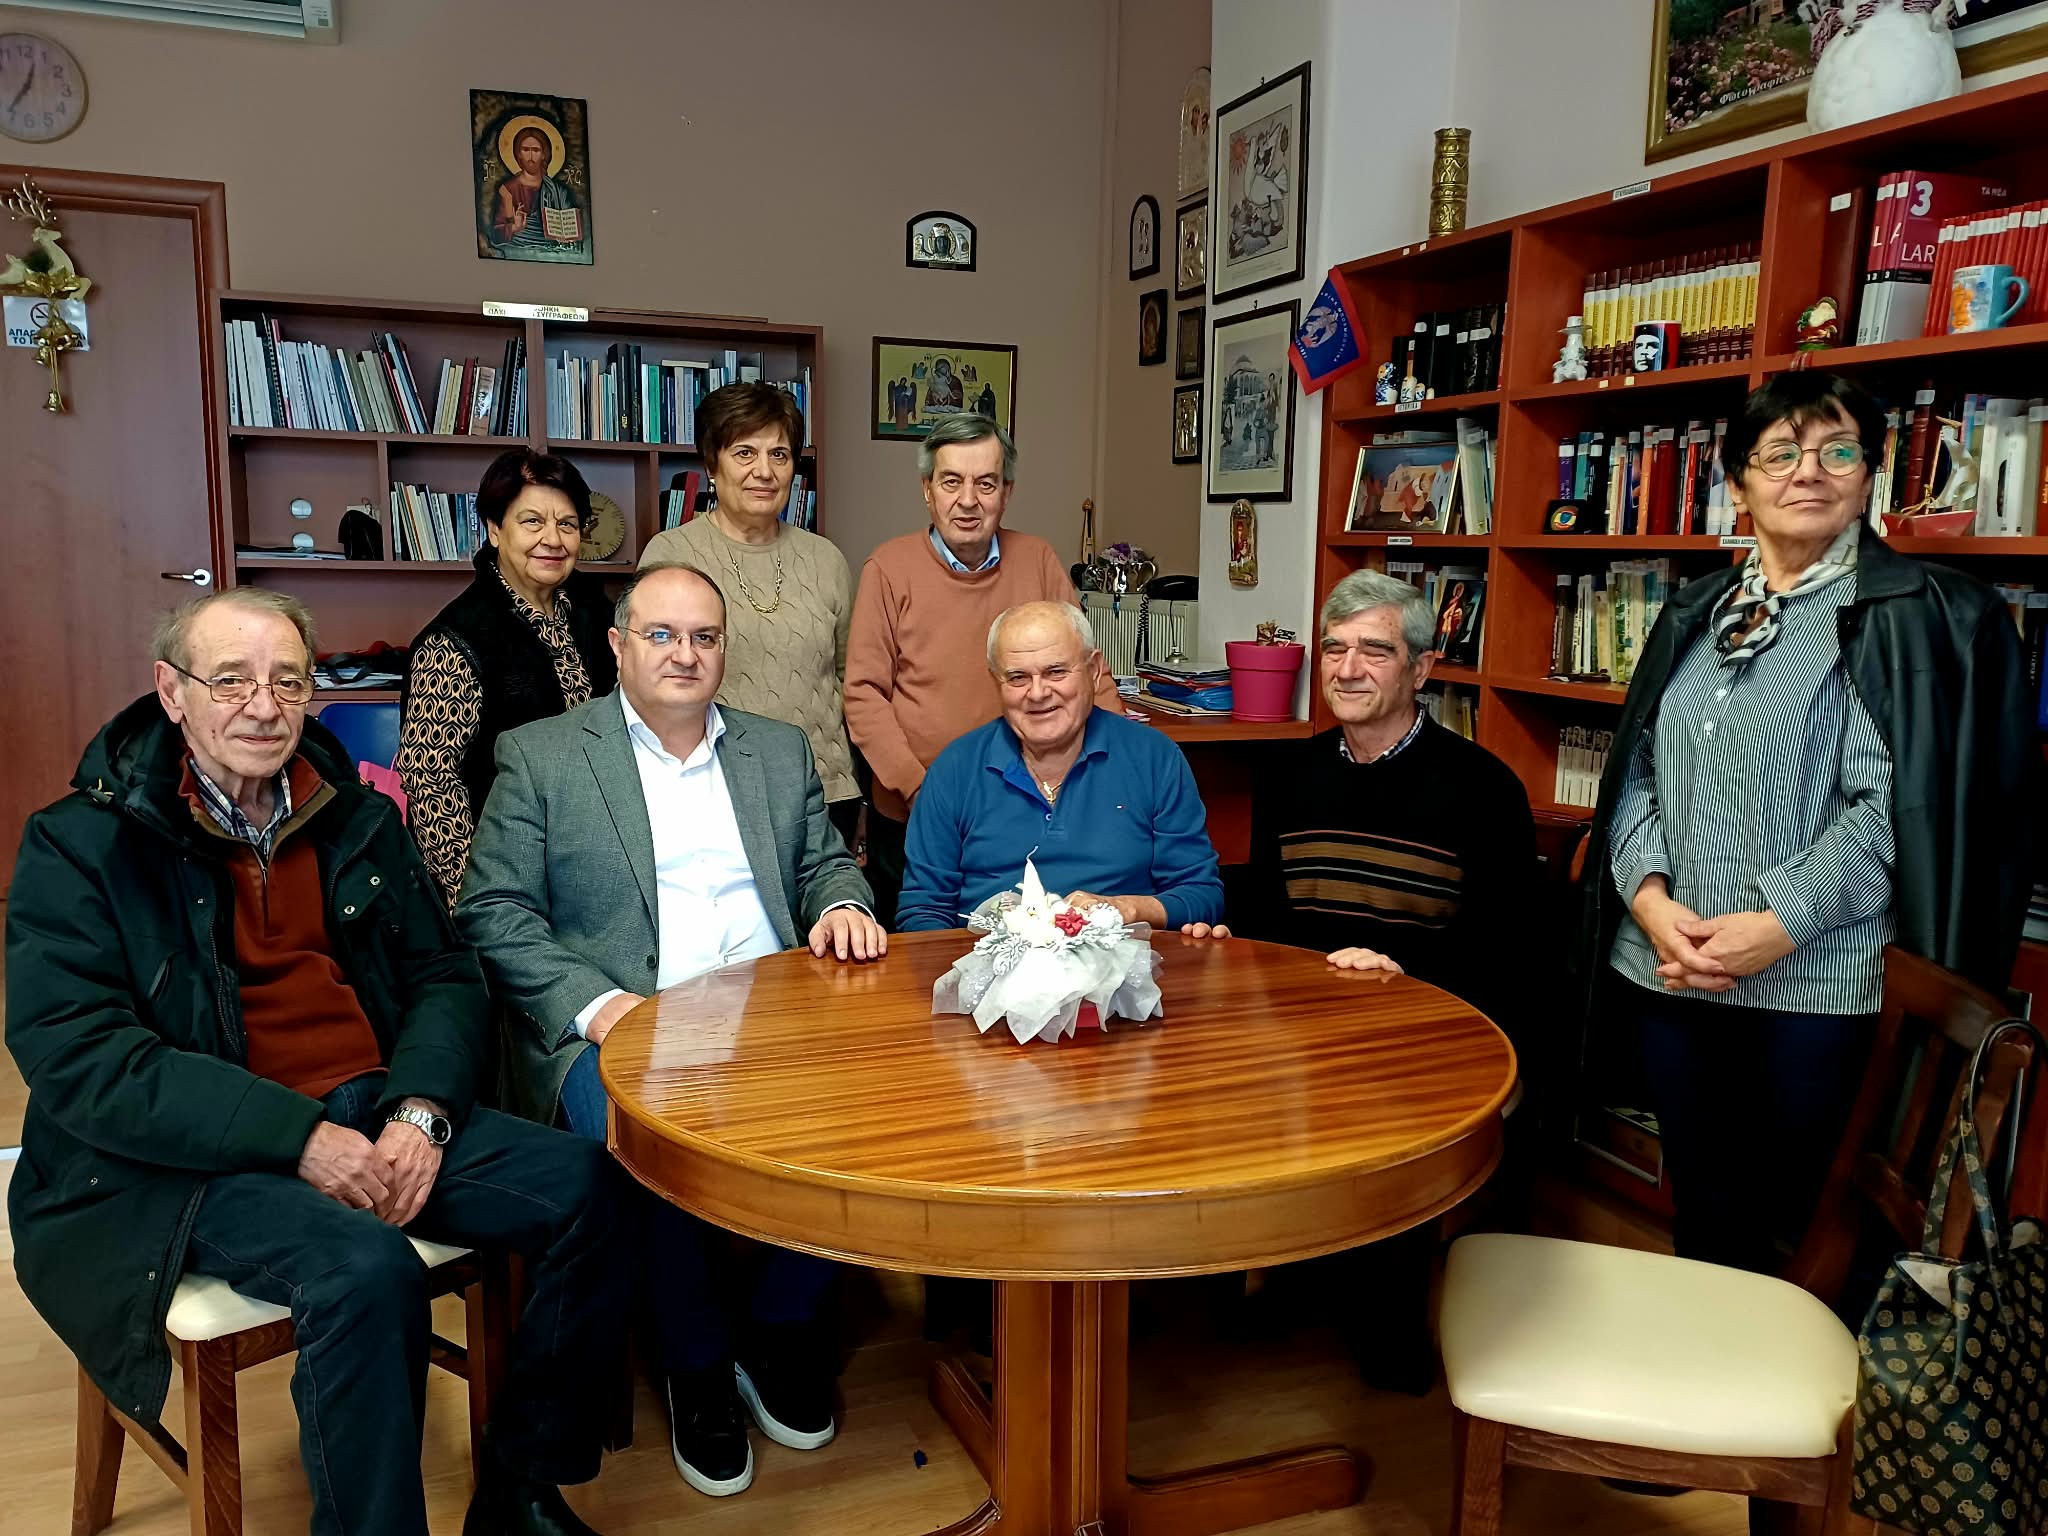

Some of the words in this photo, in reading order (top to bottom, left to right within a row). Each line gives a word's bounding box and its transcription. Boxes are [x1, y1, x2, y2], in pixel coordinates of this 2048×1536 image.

[16, 46, 33, 58] 12
[53, 65, 63, 78] 2
[61, 83, 72, 97] 3
[24, 113, 34, 128] 6
[43, 112, 54, 128] 5
[1910, 181, 1933, 216] 3
[13, 337, 26, 345] ΤΟ
